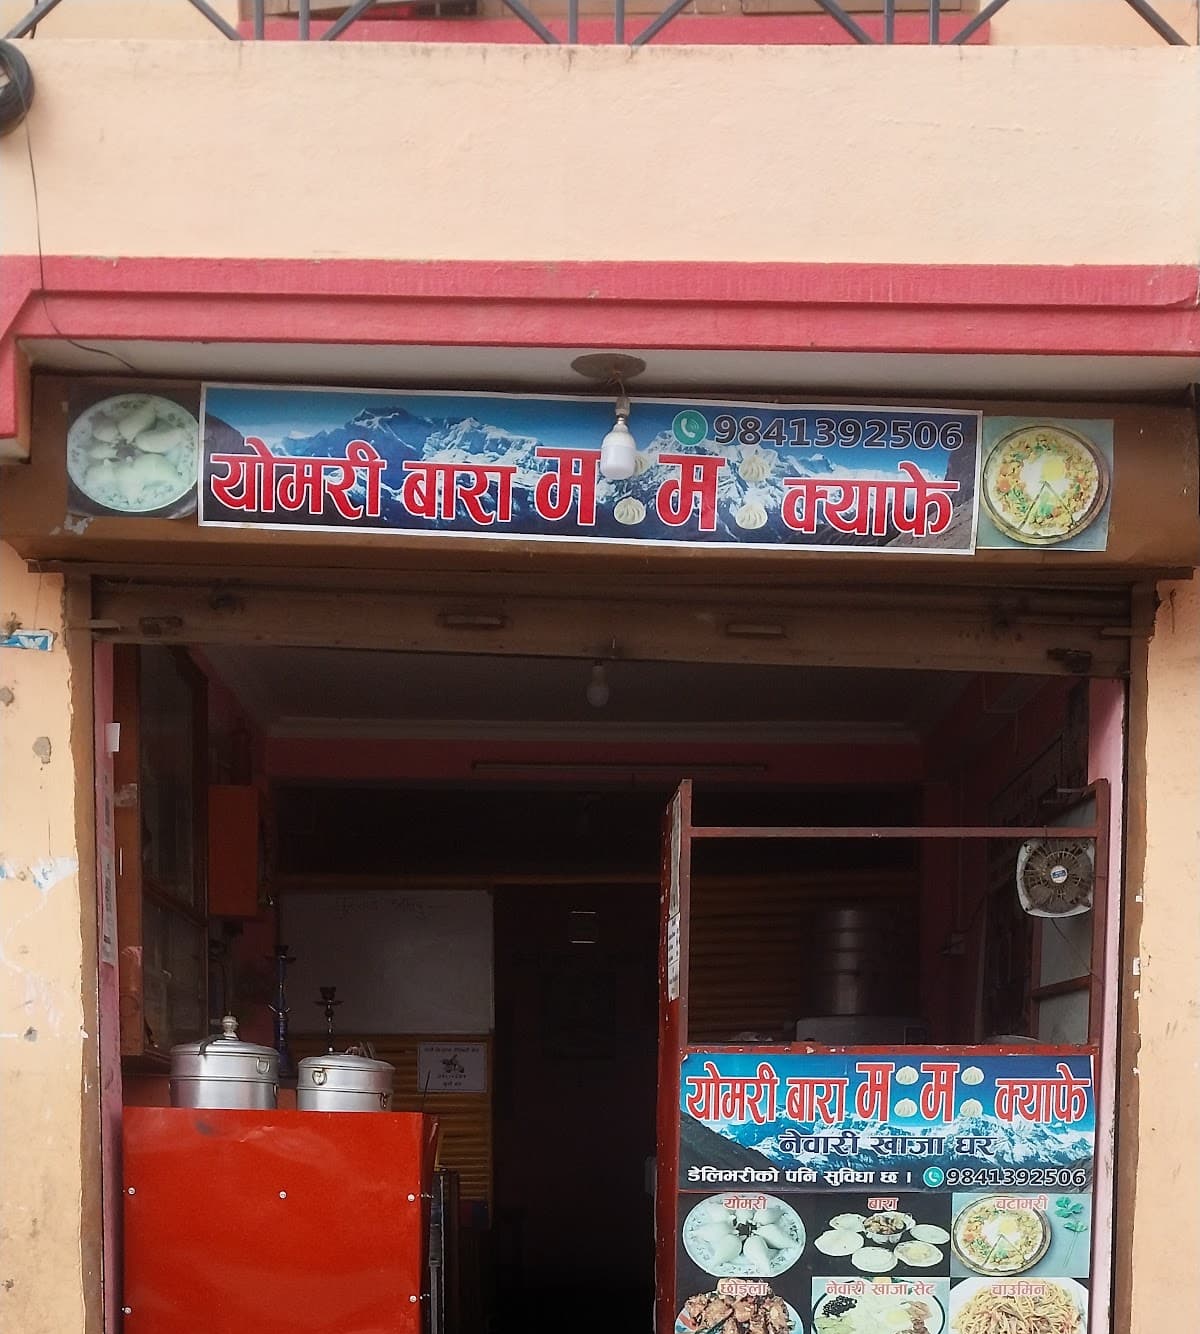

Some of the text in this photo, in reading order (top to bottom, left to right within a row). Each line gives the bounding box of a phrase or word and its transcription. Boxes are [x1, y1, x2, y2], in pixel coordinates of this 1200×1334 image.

[713, 414, 964, 450] 9841392506
[210, 436, 388, 521] योमरी
[402, 460, 518, 526] बारा
[781, 461, 962, 538] क्याफे
[685, 1061, 779, 1123] योमरी
[786, 1076, 849, 1125] बारा
[994, 1063, 1091, 1125] क्याफे
[778, 1129, 999, 1156] नेवारी खाजा घर
[687, 1166, 780, 1184] डेलिभरीको
[785, 1168, 817, 1183] पनि
[946, 1168, 1087, 1186] 9841392506
[723, 1195, 768, 1210] योमरी
[867, 1197, 899, 1210] बारा
[995, 1194, 1049, 1211] चटामरी
[826, 1280, 936, 1296] नेवारी खाजा सेट
[991, 1280, 1046, 1296] चाउमिन
